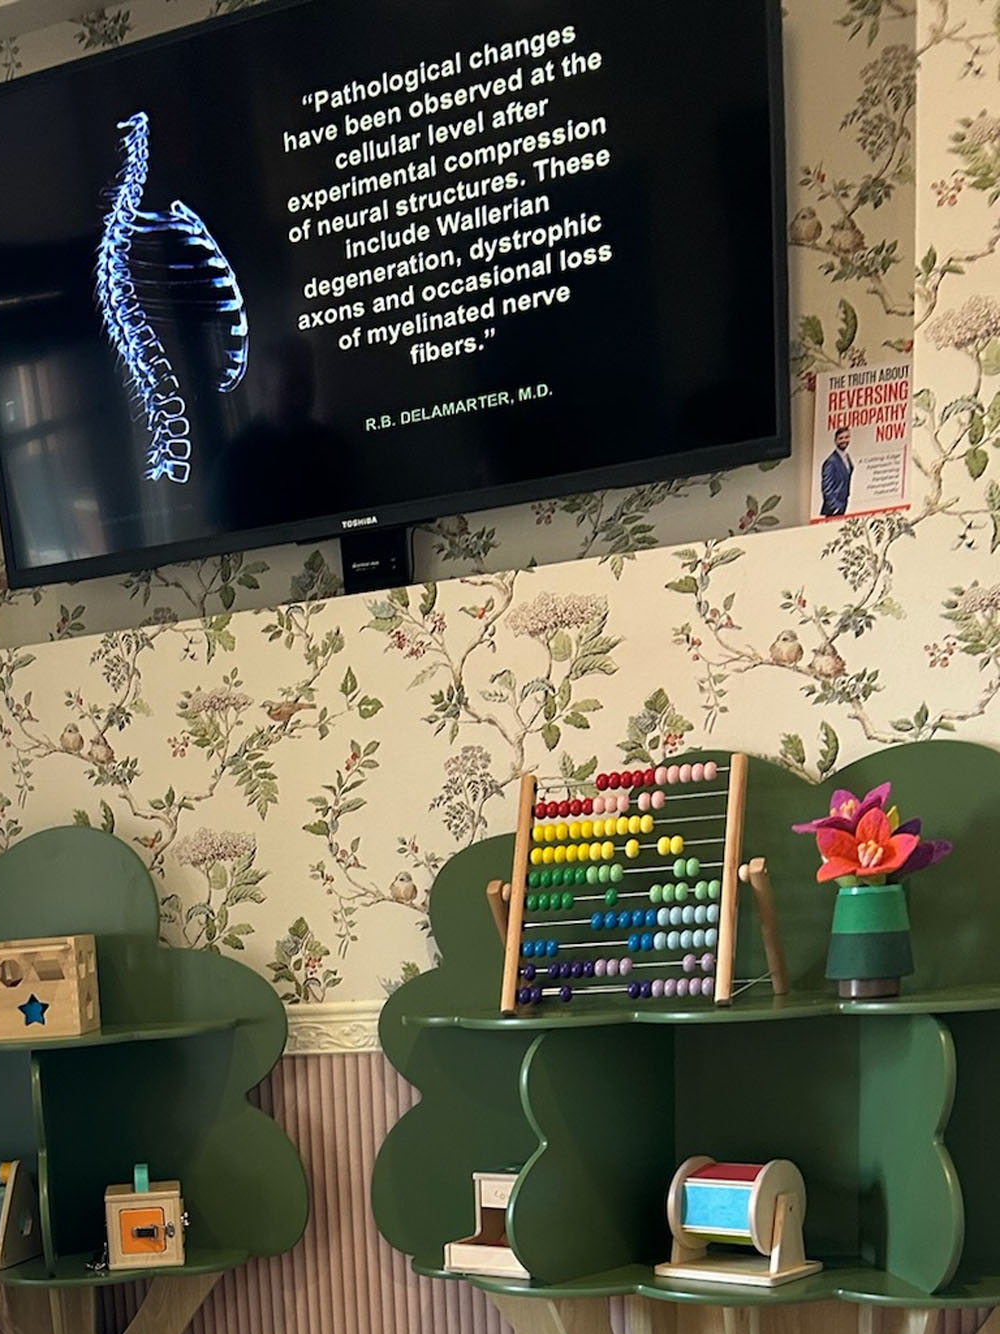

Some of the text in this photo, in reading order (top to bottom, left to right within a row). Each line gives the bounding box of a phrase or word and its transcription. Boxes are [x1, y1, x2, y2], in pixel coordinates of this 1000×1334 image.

[301, 25, 576, 113] “Pathological changes
[283, 51, 603, 153] have been observed at the
[335, 98, 549, 170] cellular level after
[287, 116, 607, 213] experimental compression
[288, 148, 611, 243] of neural structures. These
[303, 212, 602, 299] degeneration, dystrophic
[345, 195, 550, 260] include Wallerian
[297, 244, 613, 331] axons and occasional loss
[338, 285, 571, 350] of myelinated nerve
[409, 327, 496, 365] fibers.”
[829, 365, 910, 390] THE TRUTH ABOUT
[365, 383, 553, 432] R.B. DELAMARTER, M.D.
[827, 403, 907, 432] NEUROPATHY
[828, 380, 909, 412] REVERSING
[875, 423, 906, 442] NOW
[341, 516, 378, 529] TOSHIBA
